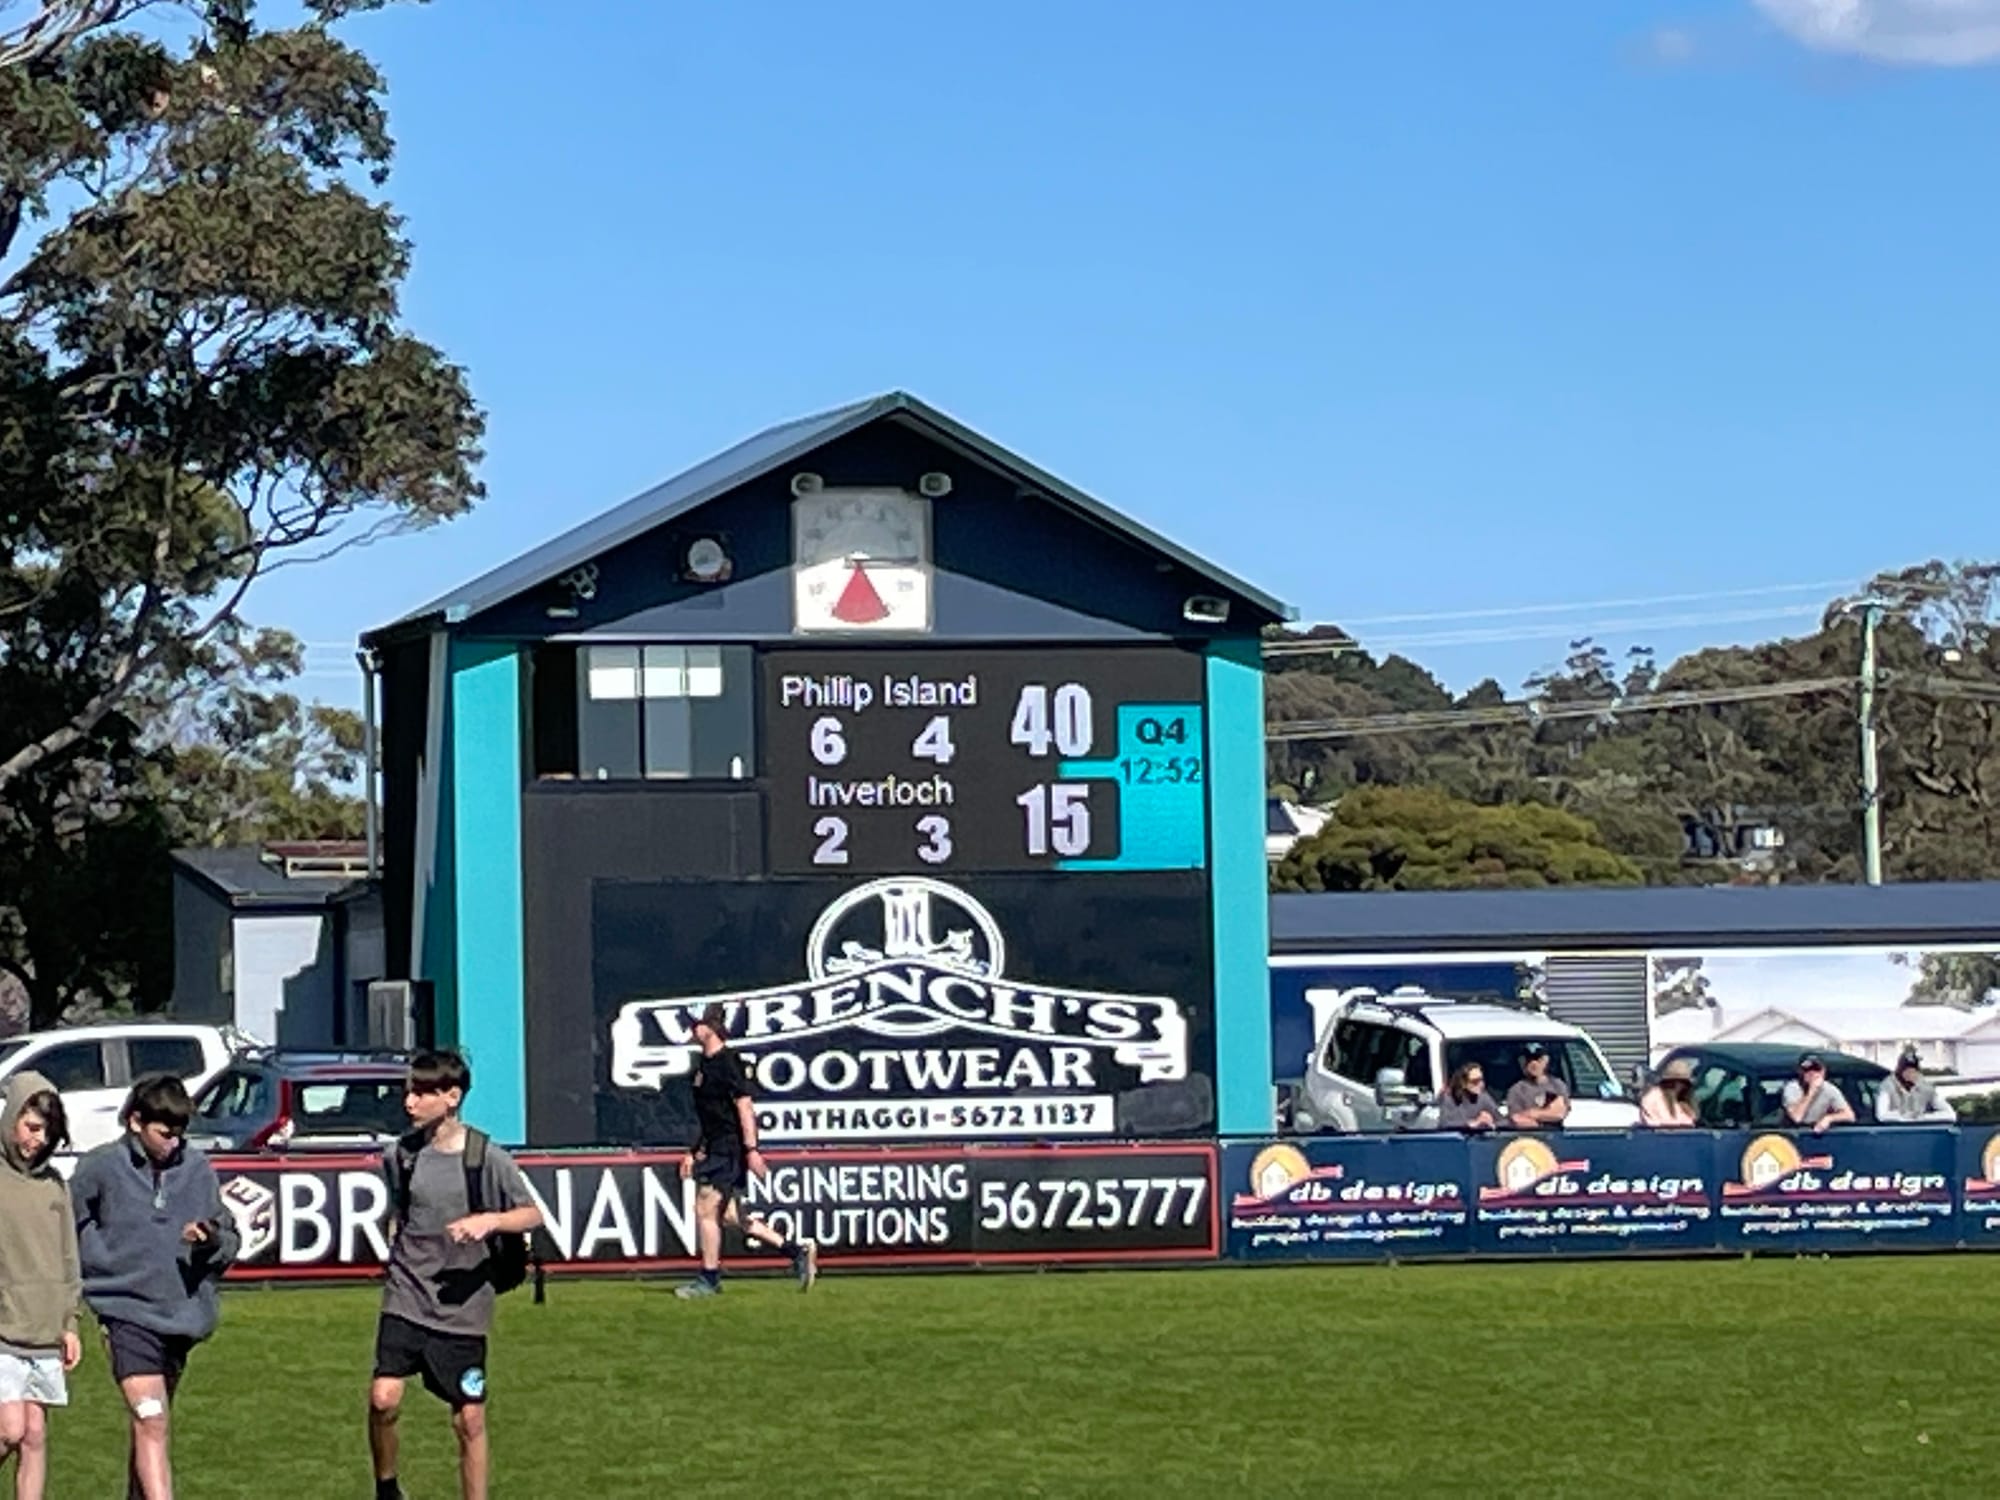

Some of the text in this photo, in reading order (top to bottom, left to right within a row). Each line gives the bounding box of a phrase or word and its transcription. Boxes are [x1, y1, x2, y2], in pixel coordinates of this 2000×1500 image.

[782, 675, 977, 712] Phillip Island
[1010, 683, 1094, 757] 40
[1136, 717, 1188, 746] Q4
[811, 716, 955, 764] 6 4
[808, 774, 954, 806] Inverloch
[1120, 757, 1201, 785] 12:52
[1016, 784, 1090, 856] 15
[813, 815, 952, 864] 2 3
[739, 1047, 1096, 1092] OOTWEAR
[742, 1164, 968, 1204] NGINEERING
[1289, 1179, 1459, 1205] db design
[1535, 1173, 1704, 1200] db design
[1778, 1170, 1946, 1196] db design
[980, 1177, 1207, 1230] 56725777
